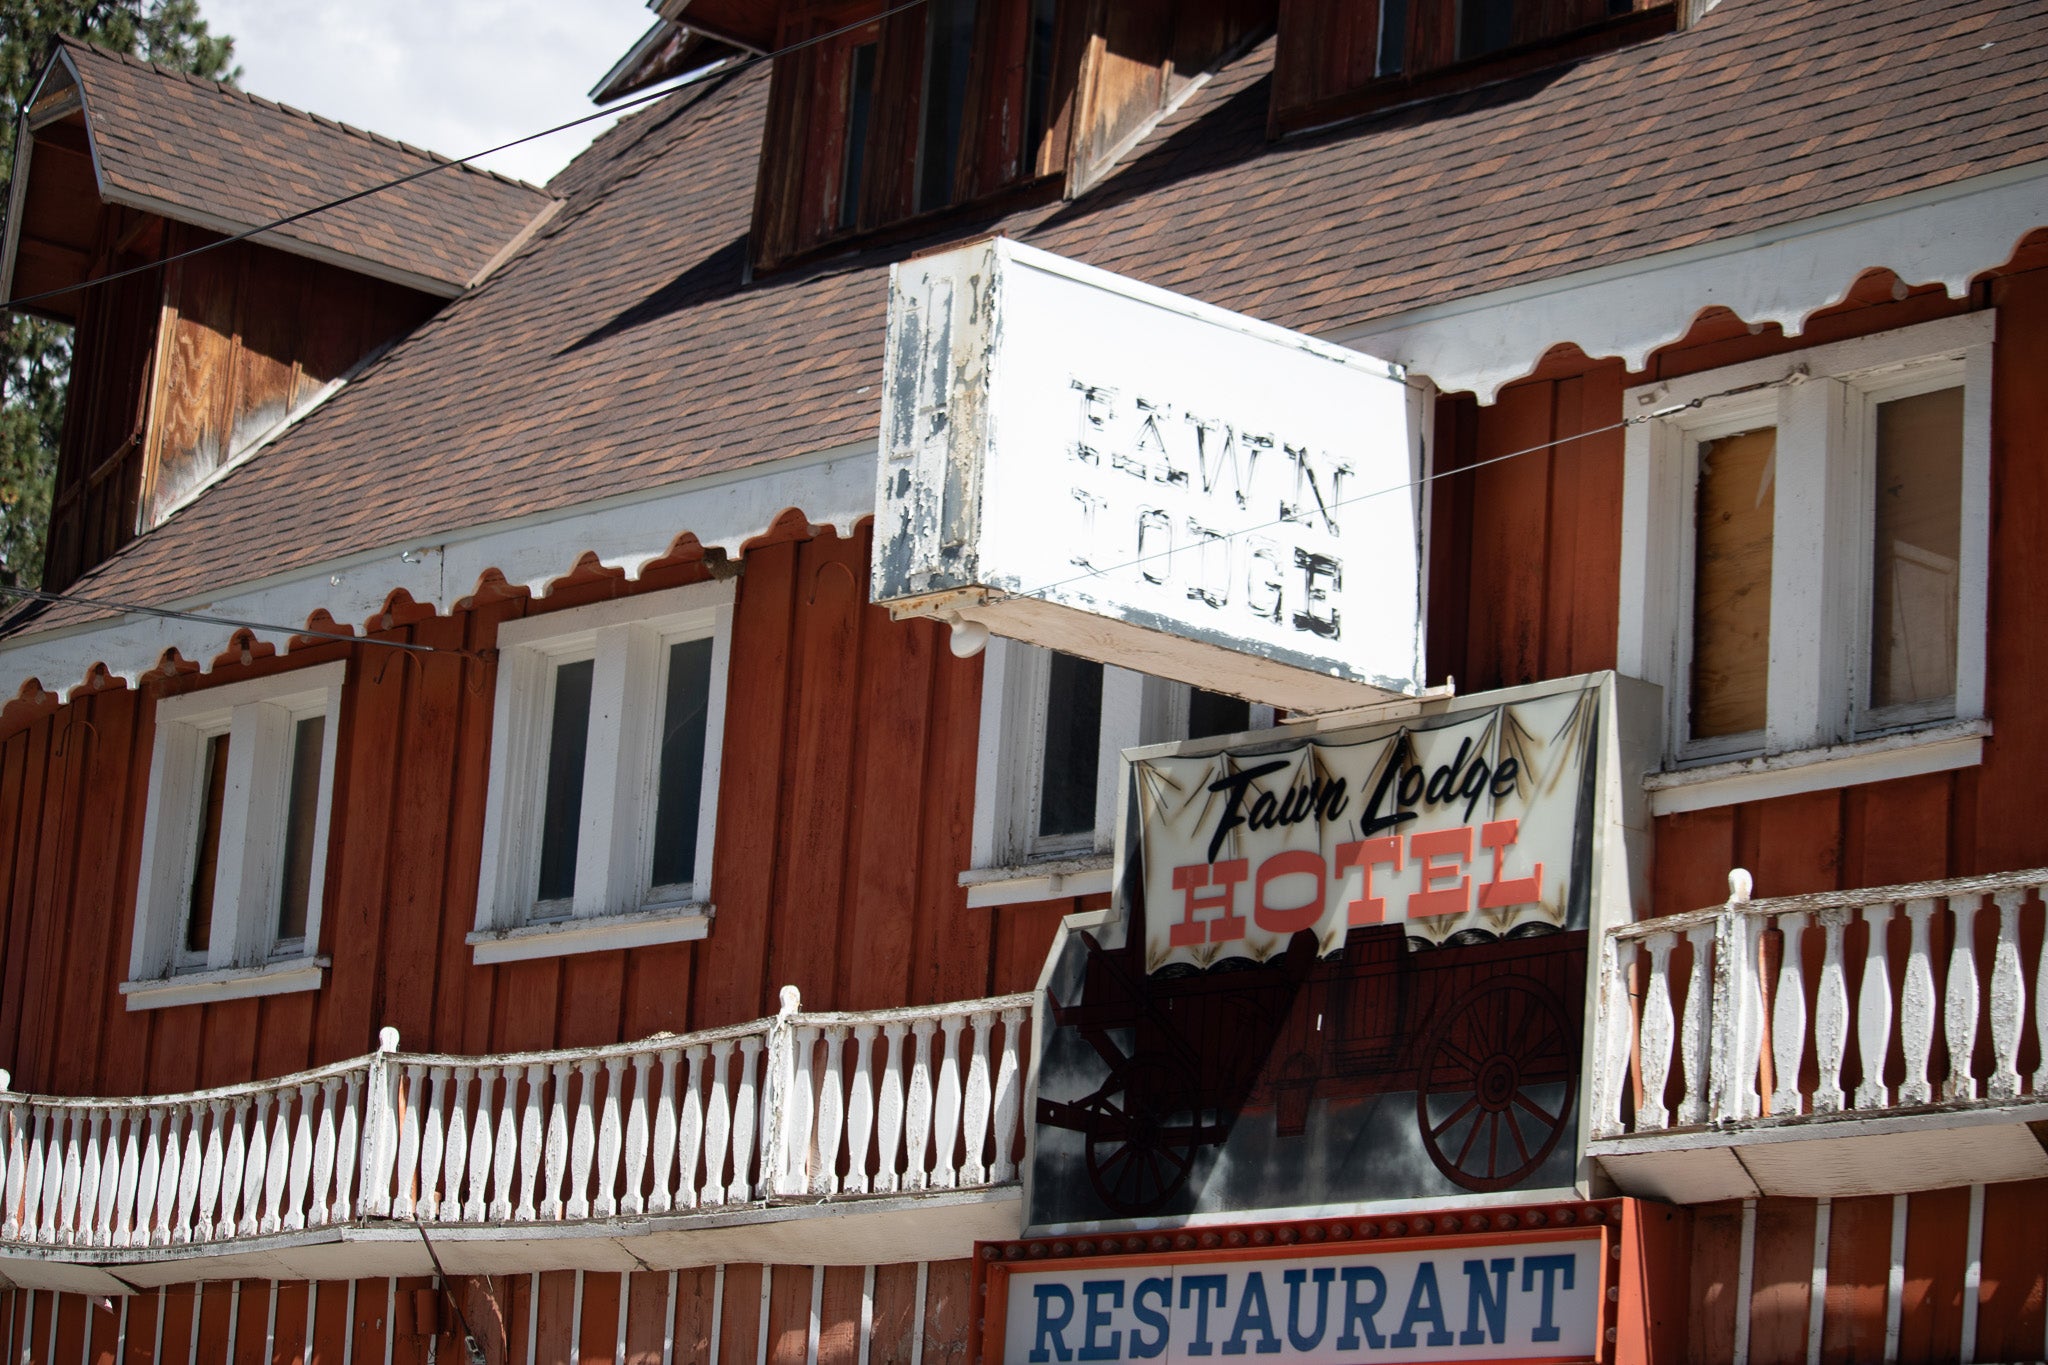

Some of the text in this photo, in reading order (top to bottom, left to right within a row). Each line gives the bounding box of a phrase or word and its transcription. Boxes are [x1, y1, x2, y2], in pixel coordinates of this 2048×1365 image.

[1208, 734, 1519, 864] Fawn Lodge
[1169, 818, 1543, 947] HOTEL
[1028, 1253, 1577, 1363] RESTAURANT
